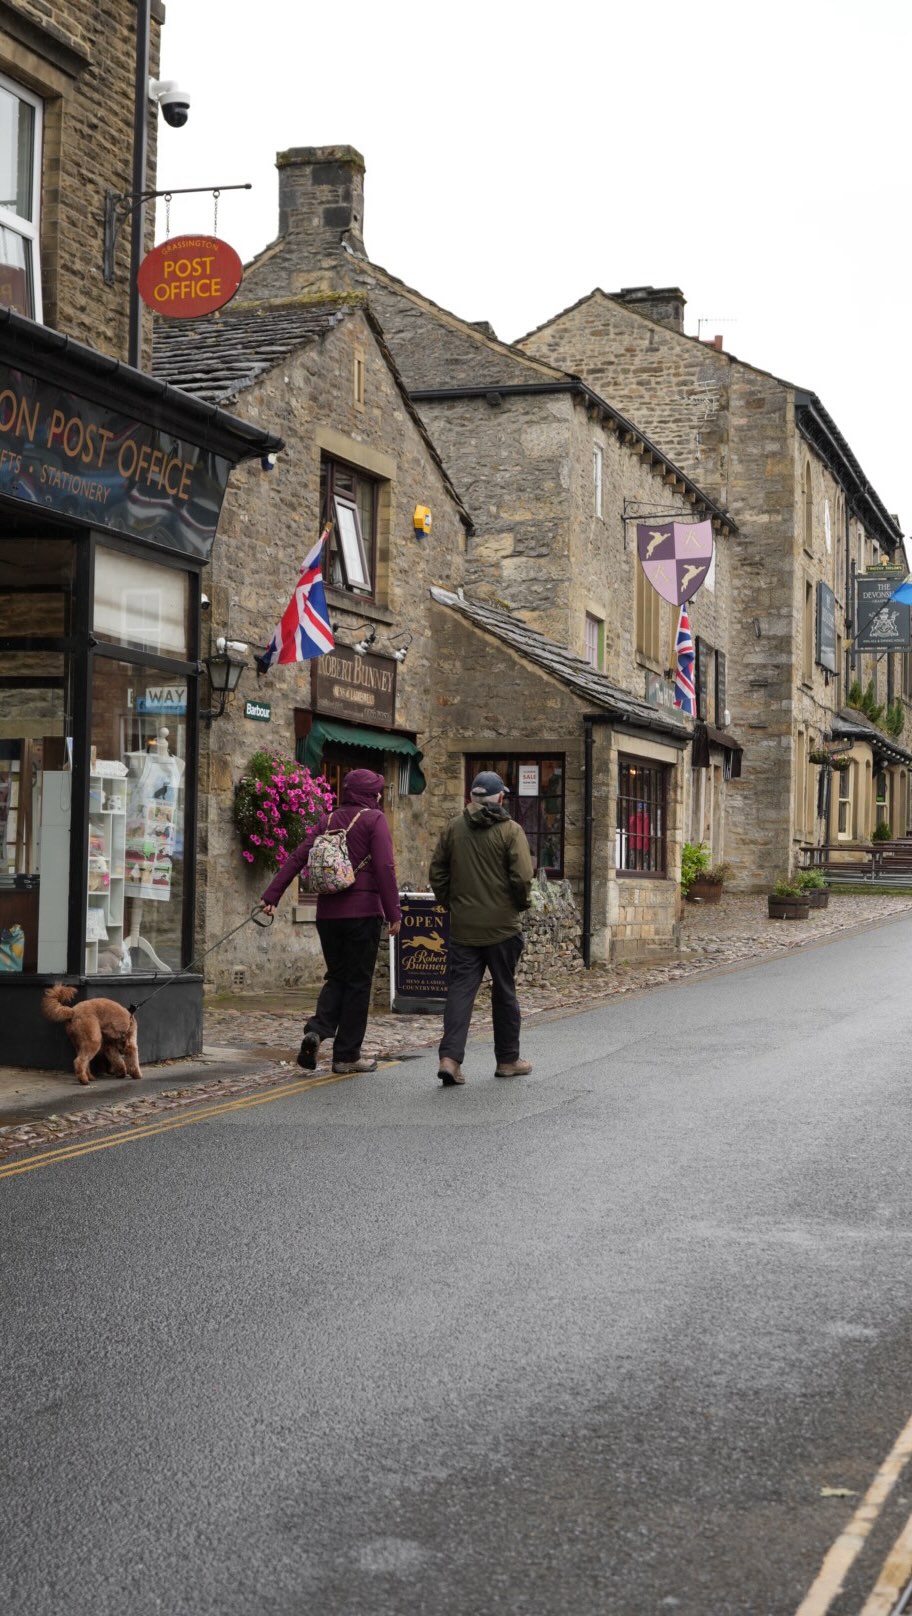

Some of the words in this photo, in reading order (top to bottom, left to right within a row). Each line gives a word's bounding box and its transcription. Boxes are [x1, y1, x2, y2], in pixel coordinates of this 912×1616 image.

[161, 240, 219, 255] GRASSINGTON
[164, 257, 215, 279] POST
[154, 279, 221, 302] OFFICE
[47, 409, 114, 468] POST
[117, 439, 194, 500] OFFICE
[40, 464, 111, 505] STATIONERY
[863, 591, 895, 599] DEVONSH
[877, 583, 891, 591] THE
[353, 654, 394, 692] BUNNEY
[148, 689, 185, 703] WAY
[246, 702, 270, 718] Barbour
[404, 915, 443, 927] OPEN
[414, 949, 447, 963] Robert
[401, 956, 447, 975] Bunney
